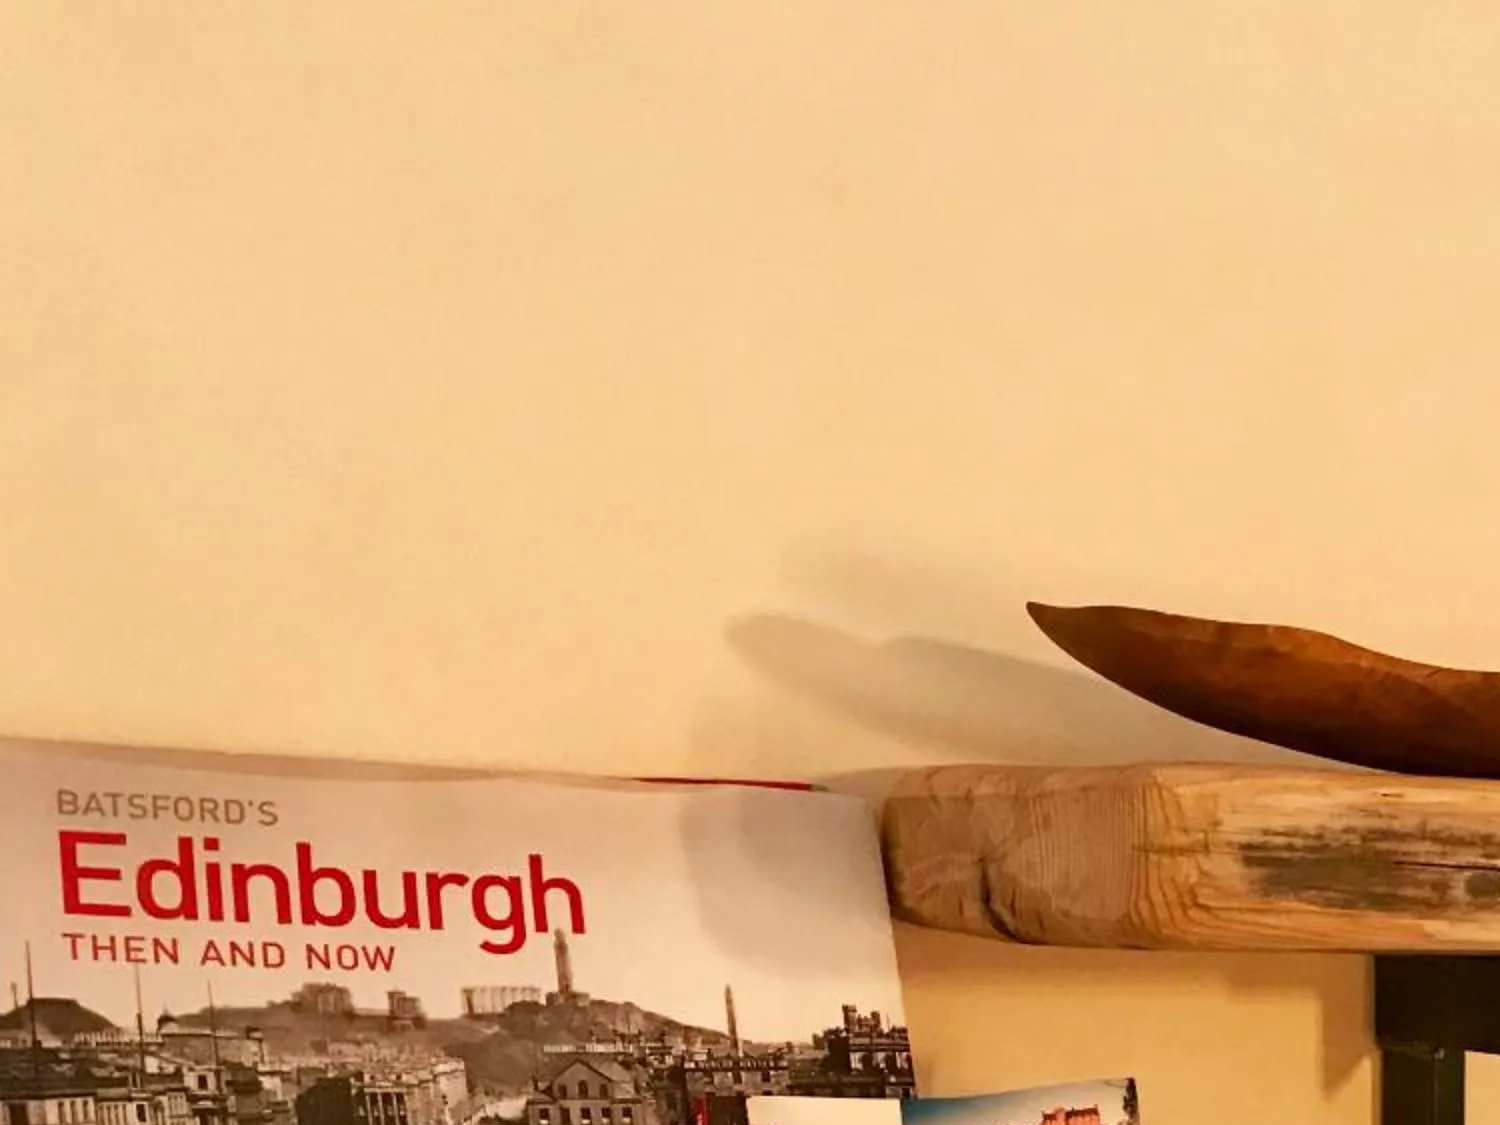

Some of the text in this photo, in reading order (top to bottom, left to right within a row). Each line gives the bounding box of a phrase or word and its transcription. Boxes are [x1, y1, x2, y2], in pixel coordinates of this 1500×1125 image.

[57, 789, 280, 827] BATSFORD'S
[58, 830, 586, 955] Edinburgh
[62, 932, 396, 973] THEN AND NOW
